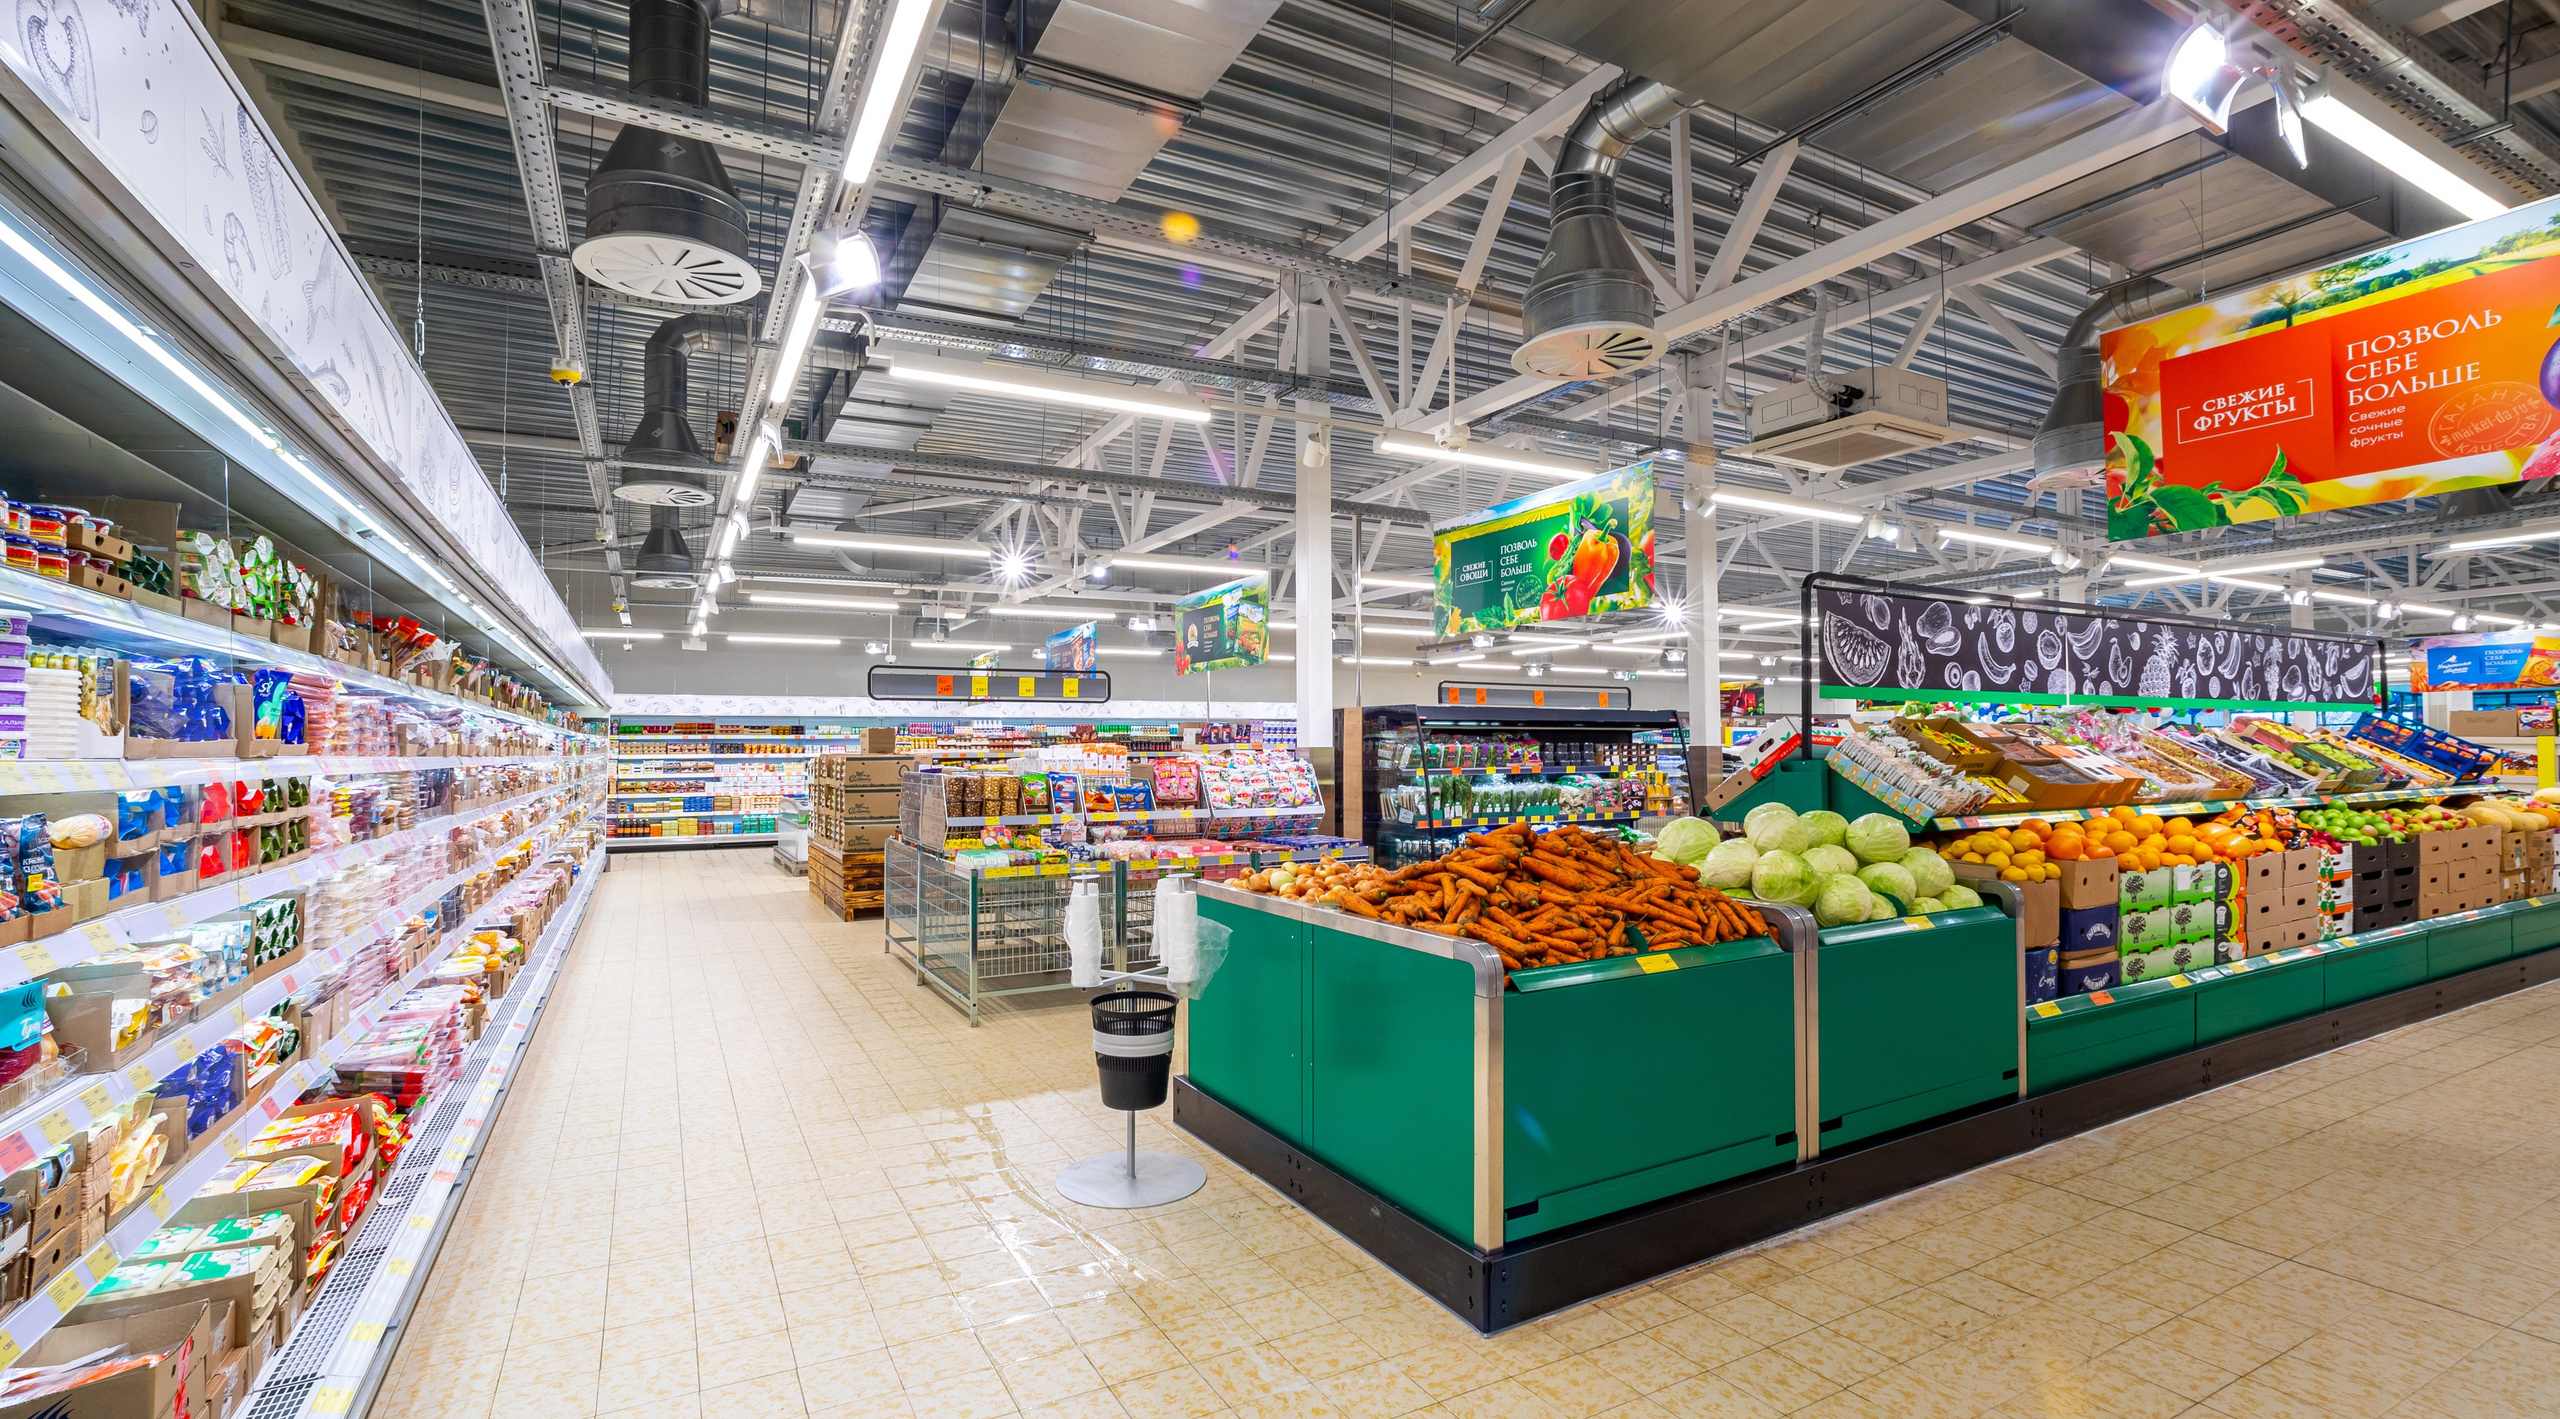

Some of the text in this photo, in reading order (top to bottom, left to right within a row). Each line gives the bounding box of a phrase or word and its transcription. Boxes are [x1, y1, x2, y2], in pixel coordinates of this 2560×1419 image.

[2346, 309, 2502, 361] ПОЗВОЛЬ
[2345, 352, 2419, 382] СЕБЕ
[2348, 362, 2481, 407] БОЛЬШЕ
[2202, 383, 2286, 412] СВЕЖИЕ
[2193, 396, 2297, 431] ФРУКТЫ
[2349, 405, 2406, 423] Свежие
[2439, 389, 2527, 432] ГАРАНТ
[2349, 418, 2403, 435] сочные
[2451, 403, 2529, 443] market-da.ru
[2455, 411, 2541, 455] КАЧЕСТВА
[2350, 431, 2404, 449] фрукты
[1500, 538, 1538, 555] ПОЗВОЛЬ
[1462, 561, 1486, 573] СВЕЖИЕ
[1500, 554, 1519, 566] СЕБЕ
[1500, 563, 1533, 578] БОЛЬШЕ
[1460, 569, 1489, 582] ОВОЩИ
